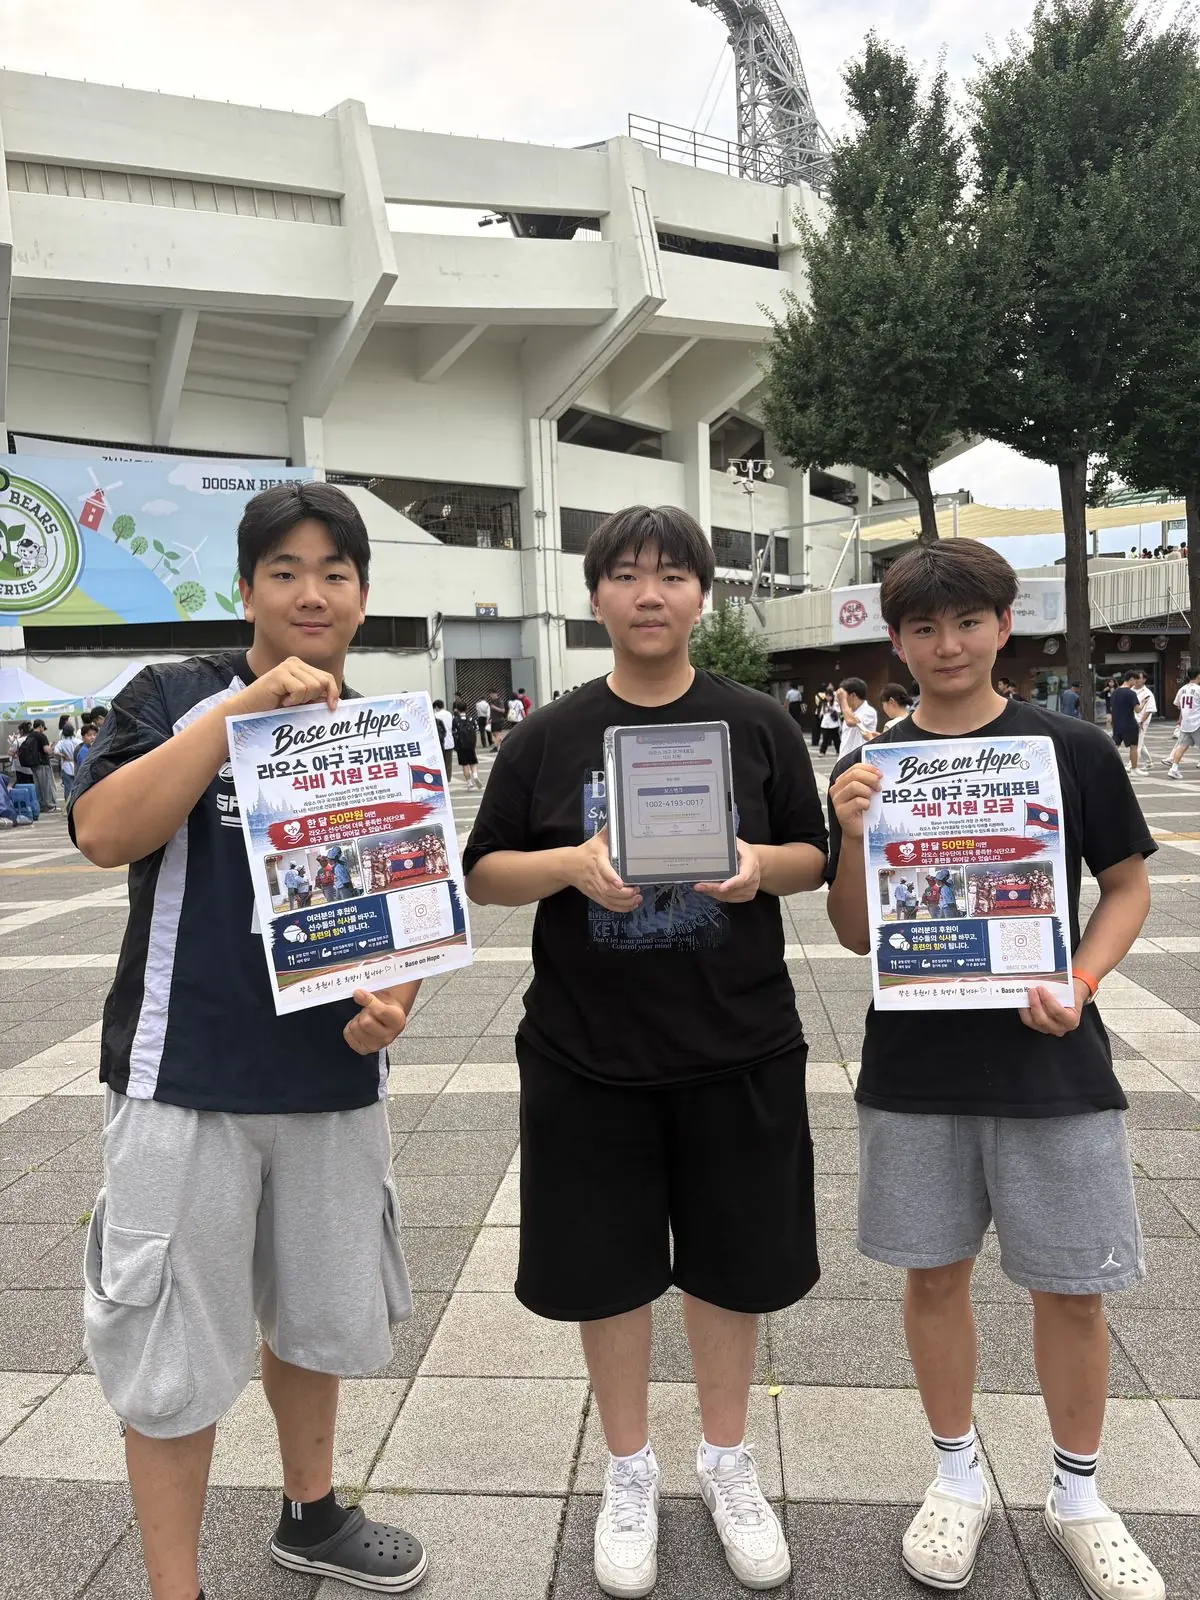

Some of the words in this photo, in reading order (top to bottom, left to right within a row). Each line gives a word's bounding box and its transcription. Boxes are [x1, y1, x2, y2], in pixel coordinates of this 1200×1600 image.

[202, 477, 256, 490] DOOSAN
[9, 490, 58, 535] BEARS
[0, 580, 38, 596] RIES
[1182, 696, 1193, 709] 14
[270, 724, 327, 757] Base
[330, 719, 353, 736] on
[355, 709, 400, 740] Hope
[256, 758, 308, 780] 라오스
[312, 752, 345, 771] 야구
[348, 741, 422, 766] 국가대표팀
[894, 756, 950, 784] Base
[952, 756, 974, 770] on
[975, 747, 1022, 775] Hope
[292, 772, 325, 792] 식비
[328, 767, 363, 786] 지원
[368, 762, 399, 781] 모금
[882, 786, 928, 804] 라오스
[932, 785, 962, 801] 야구
[966, 780, 1040, 799] 국가대표팀
[910, 803, 942, 818] 식비
[946, 800, 978, 816] 지원
[983, 798, 1014, 814] 모금
[306, 818, 317, 829] 한
[318, 816, 328, 827] 달
[328, 824, 352, 834] 선수단이
[383, 814, 406, 824] 식단으로
[324, 832, 342, 842] 훈련을
[342, 829, 360, 838] 이어갈
[369, 824, 393, 833] 있습니다.
[920, 842, 930, 851] 한
[931, 842, 940, 851] 달
[306, 910, 335, 922] 여러분의
[336, 906, 358, 917] 후원이
[308, 920, 336, 932] 선수들의
[336, 916, 357, 926] 식사를
[309, 930, 331, 942] 훈련의
[332, 926, 347, 938] 힘이
[348, 922, 370, 933] 됩니다.
[938, 926, 959, 934] 후원이
[912, 934, 938, 943] 선수들의
[637, 944, 654, 952] your
[912, 943, 932, 952] 훈련의
[934, 943, 946, 951] 힘이
[948, 942, 970, 950] 됩니다.
[404, 959, 418, 968] Base
[426, 953, 441, 964] Hope
[315, 980, 334, 992] 후원이
[344, 974, 363, 984] 희망이
